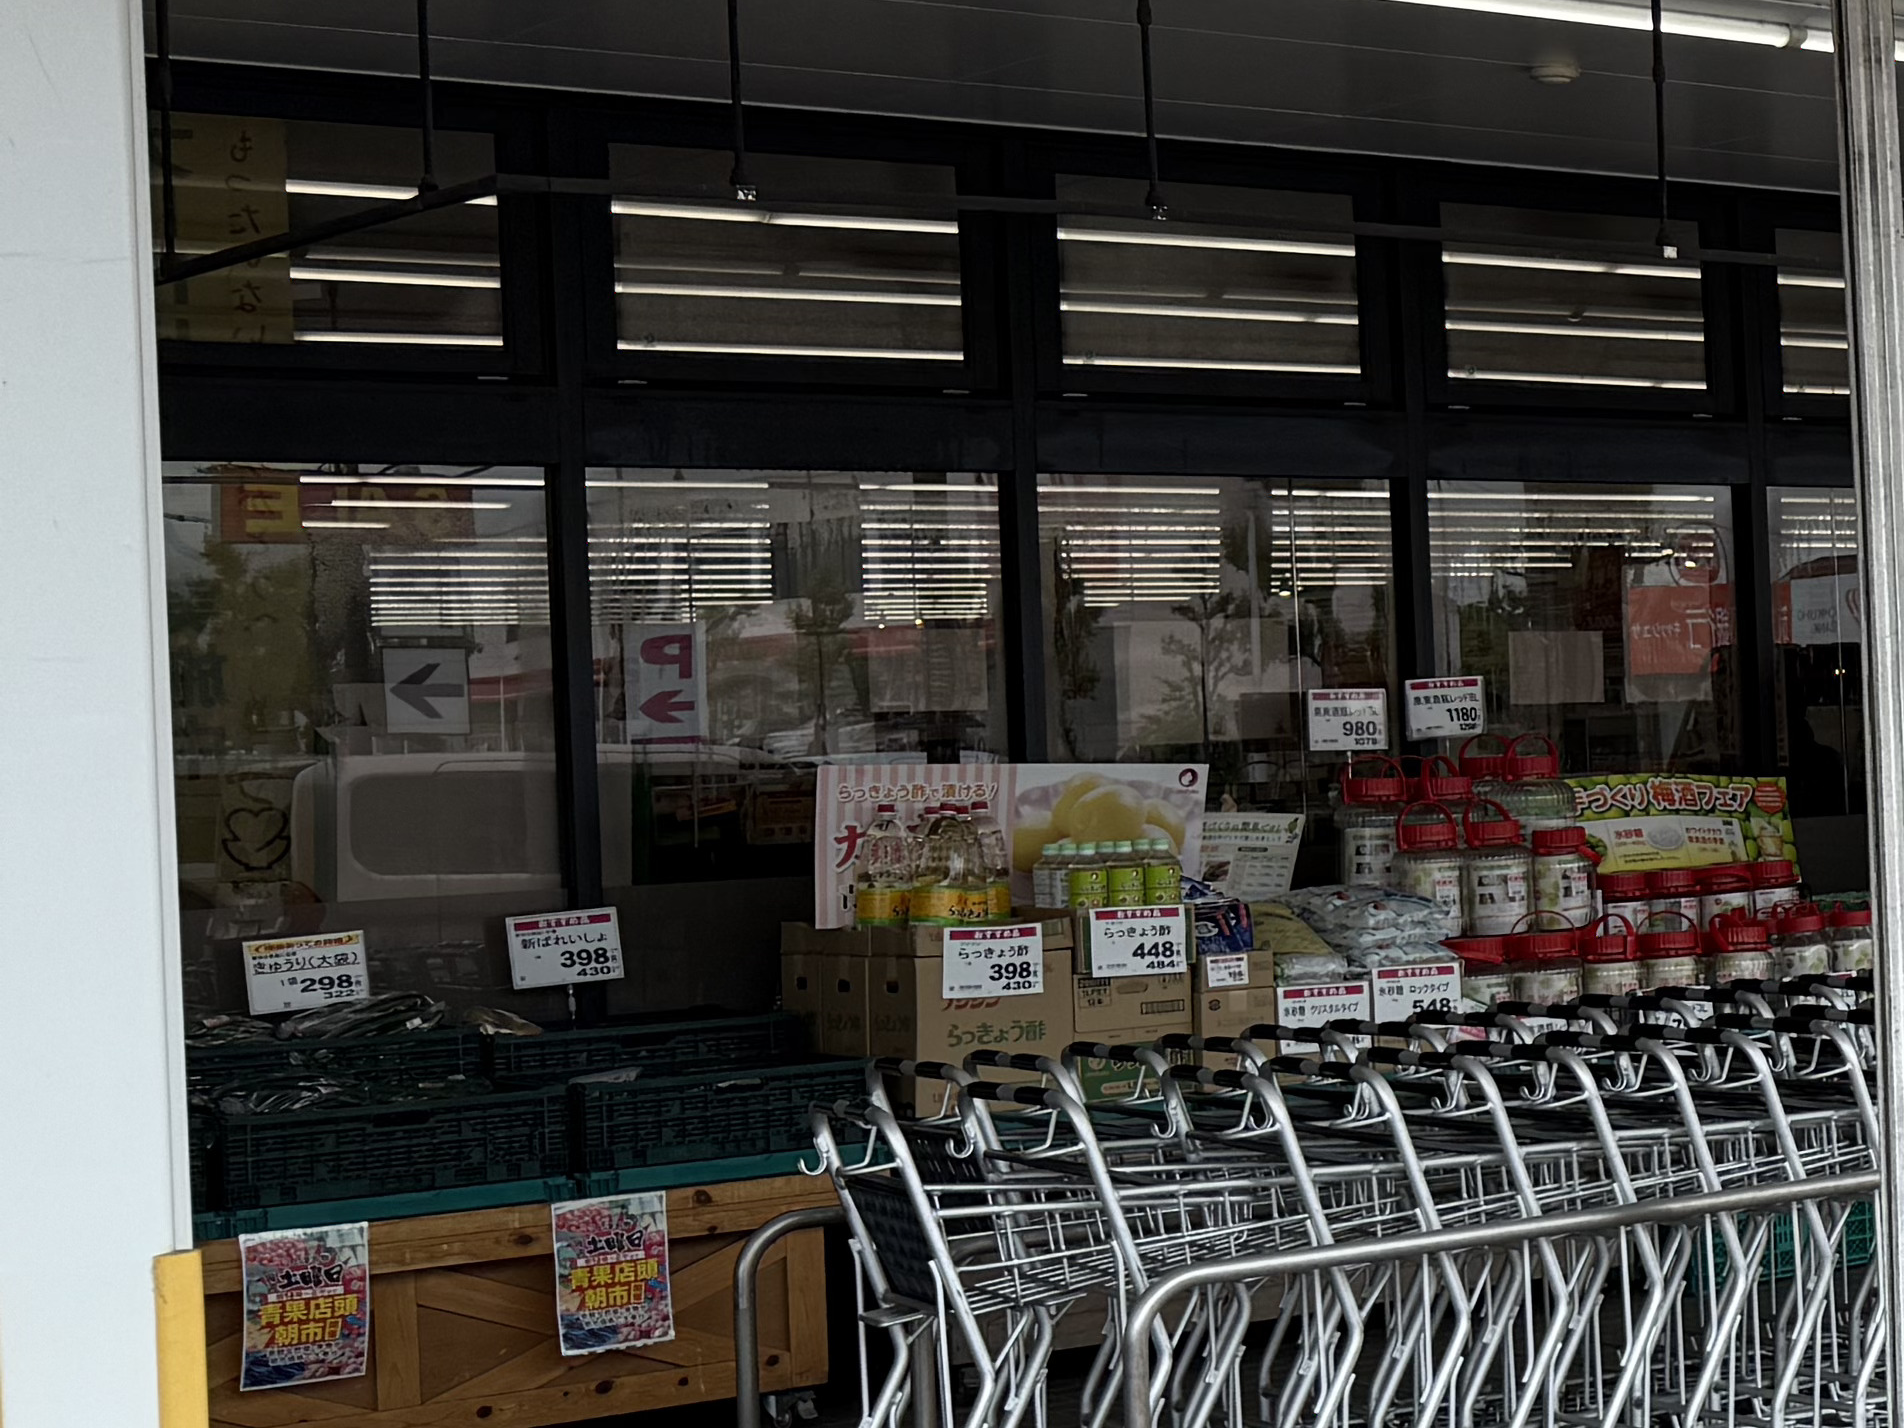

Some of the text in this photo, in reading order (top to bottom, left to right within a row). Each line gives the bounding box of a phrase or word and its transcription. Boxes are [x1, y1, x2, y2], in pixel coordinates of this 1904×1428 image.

[1446, 707, 1477, 722] 1180
[1342, 720, 1377, 736] 980
[560, 947, 610, 969] 398
[1132, 941, 1175, 959] 448
[576, 965, 612, 977] 430
[989, 961, 1032, 981] 398
[1146, 959, 1176, 970] 484
[299, 973, 353, 993] 298
[1002, 980, 1032, 991] 430
[946, 1019, 1047, 1048] らっきょう酢
